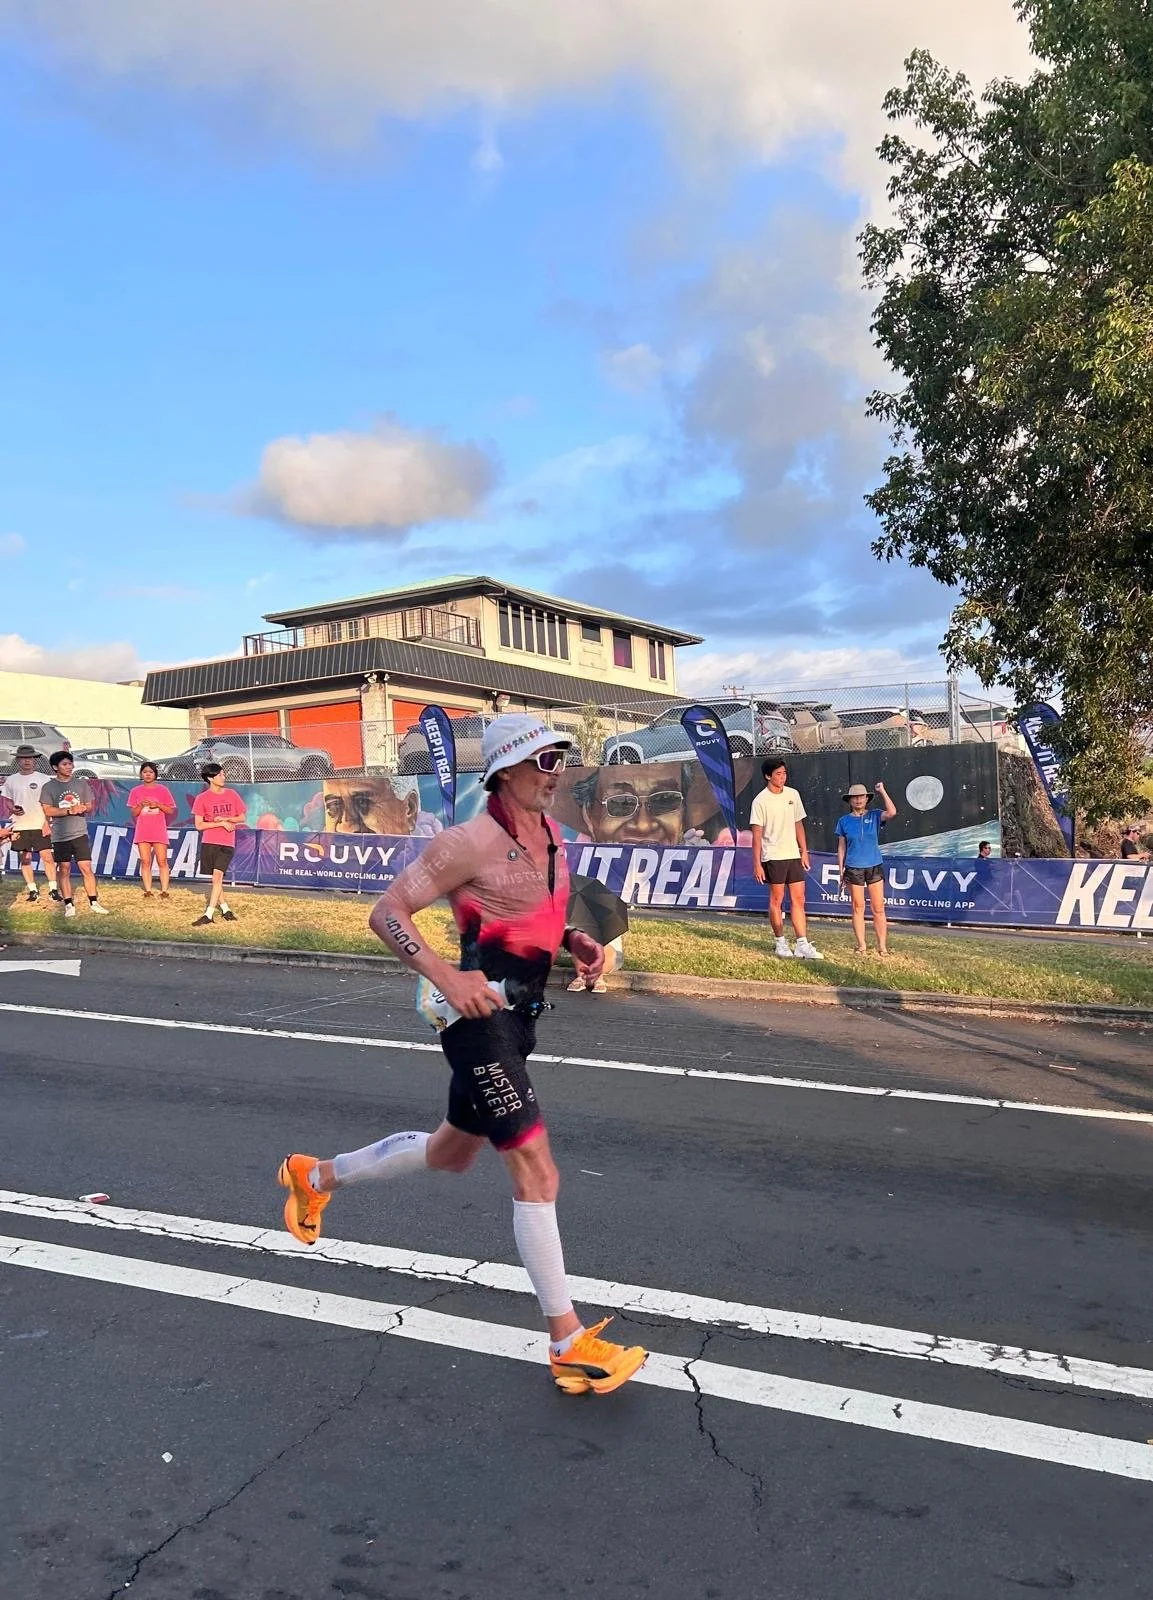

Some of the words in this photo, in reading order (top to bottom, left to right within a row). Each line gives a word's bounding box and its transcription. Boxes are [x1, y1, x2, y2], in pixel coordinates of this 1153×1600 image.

[424, 718, 442, 747] KEEP
[696, 738, 720, 746] ROUVY
[433, 746, 446, 757] IT
[436, 757, 452, 788] REAL
[90, 824, 128, 875] IT
[279, 842, 396, 866] ROUVY
[295, 869, 343, 878] REAL-WORLD
[344, 872, 376, 880] CYCLING
[576, 846, 623, 886] IT
[620, 847, 738, 908] REAL
[821, 864, 978, 893] RUVY
[821, 893, 839, 902] THE
[909, 899, 951, 908] CYCLING
[955, 901, 976, 909] APP
[473, 1066, 507, 1118] BIKER
[486, 1062, 523, 1113] MISTER
